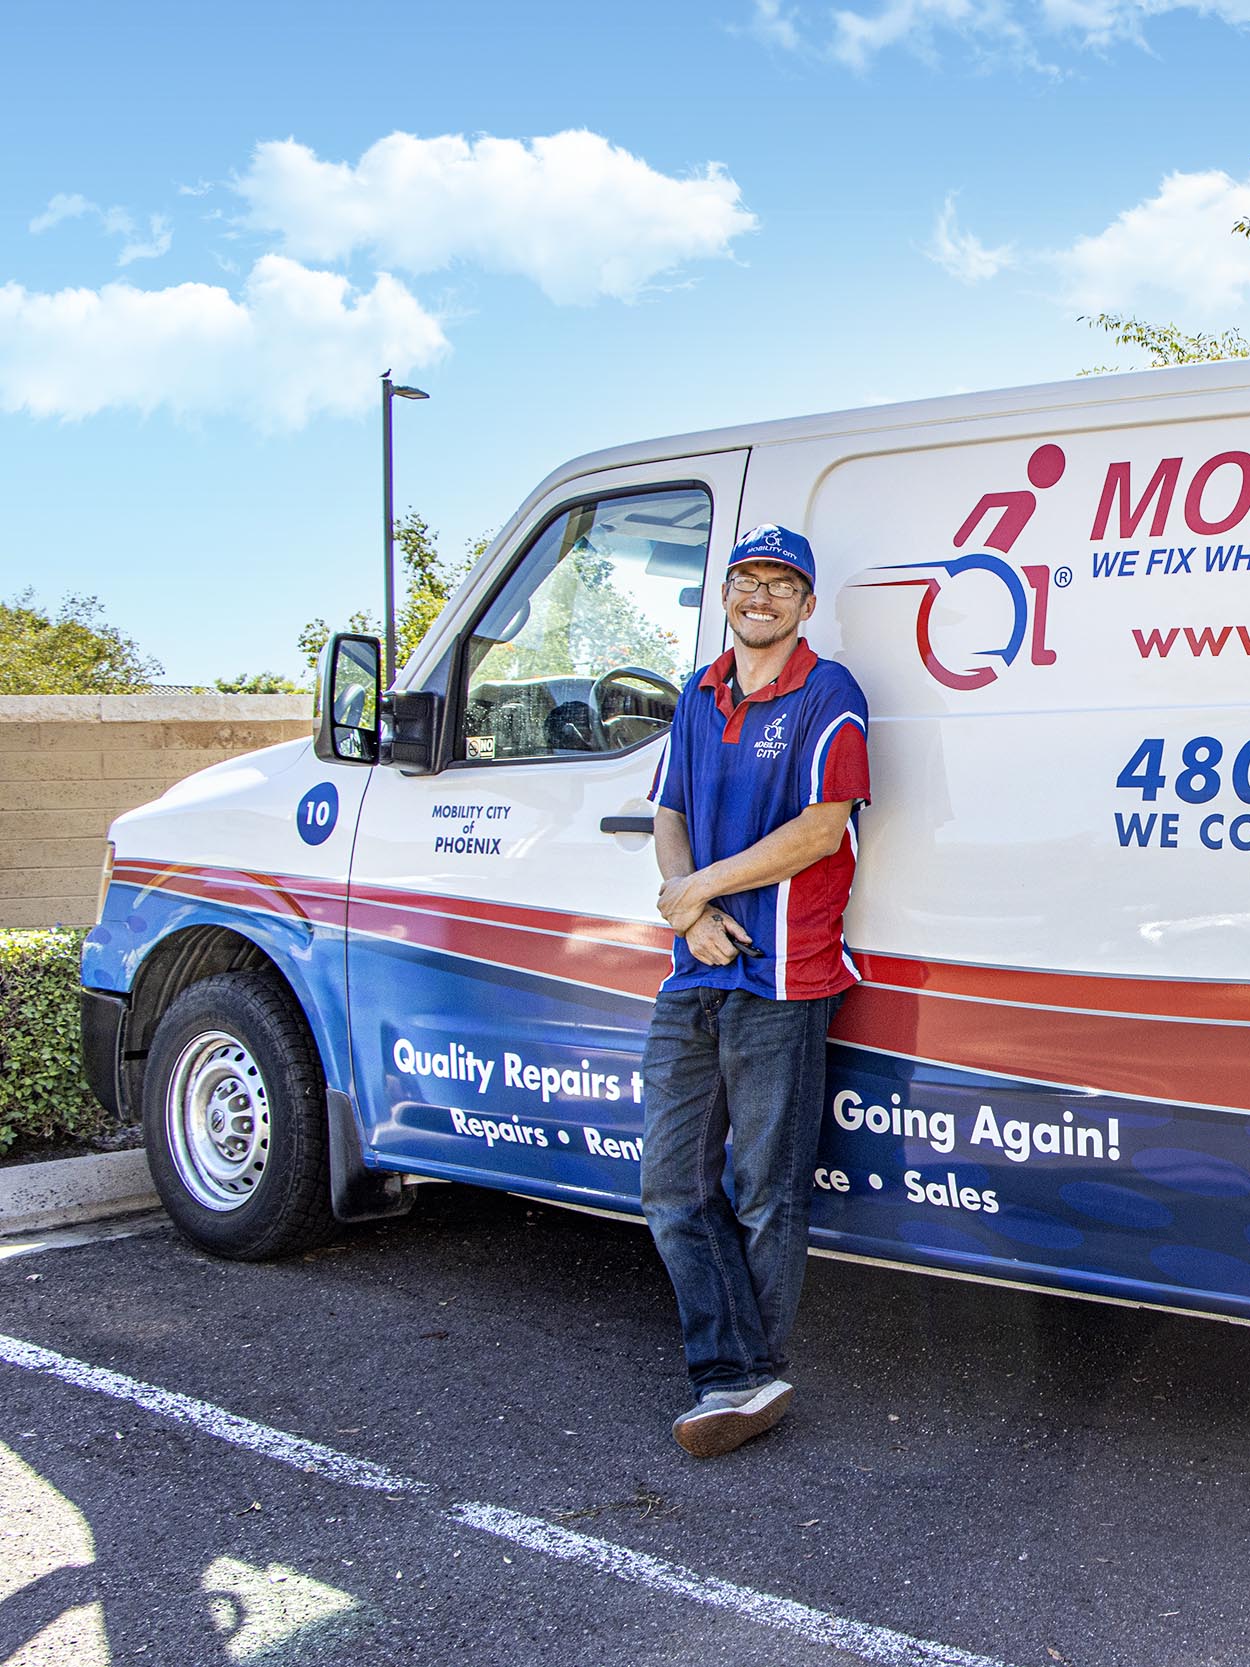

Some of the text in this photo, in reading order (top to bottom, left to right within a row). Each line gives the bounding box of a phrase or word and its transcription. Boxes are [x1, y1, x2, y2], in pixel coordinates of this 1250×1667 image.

[1092, 550, 1140, 578] WE
[1145, 547, 1196, 575] FIX
[753, 741, 788, 750] MOBILITY
[756, 748, 781, 759] CITY
[306, 801, 330, 827] 10
[432, 805, 511, 820] MOBILITY CITY
[462, 820, 475, 834] of
[1114, 812, 1180, 848] WE
[434, 837, 501, 855] PHOENIX
[393, 1038, 495, 1094] Quality
[504, 1052, 621, 1103] Repairs
[832, 1089, 955, 1154] Going
[969, 1105, 1121, 1163] Again!
[450, 1107, 549, 1148] Repairs
[904, 1170, 1000, 1214] Sales
